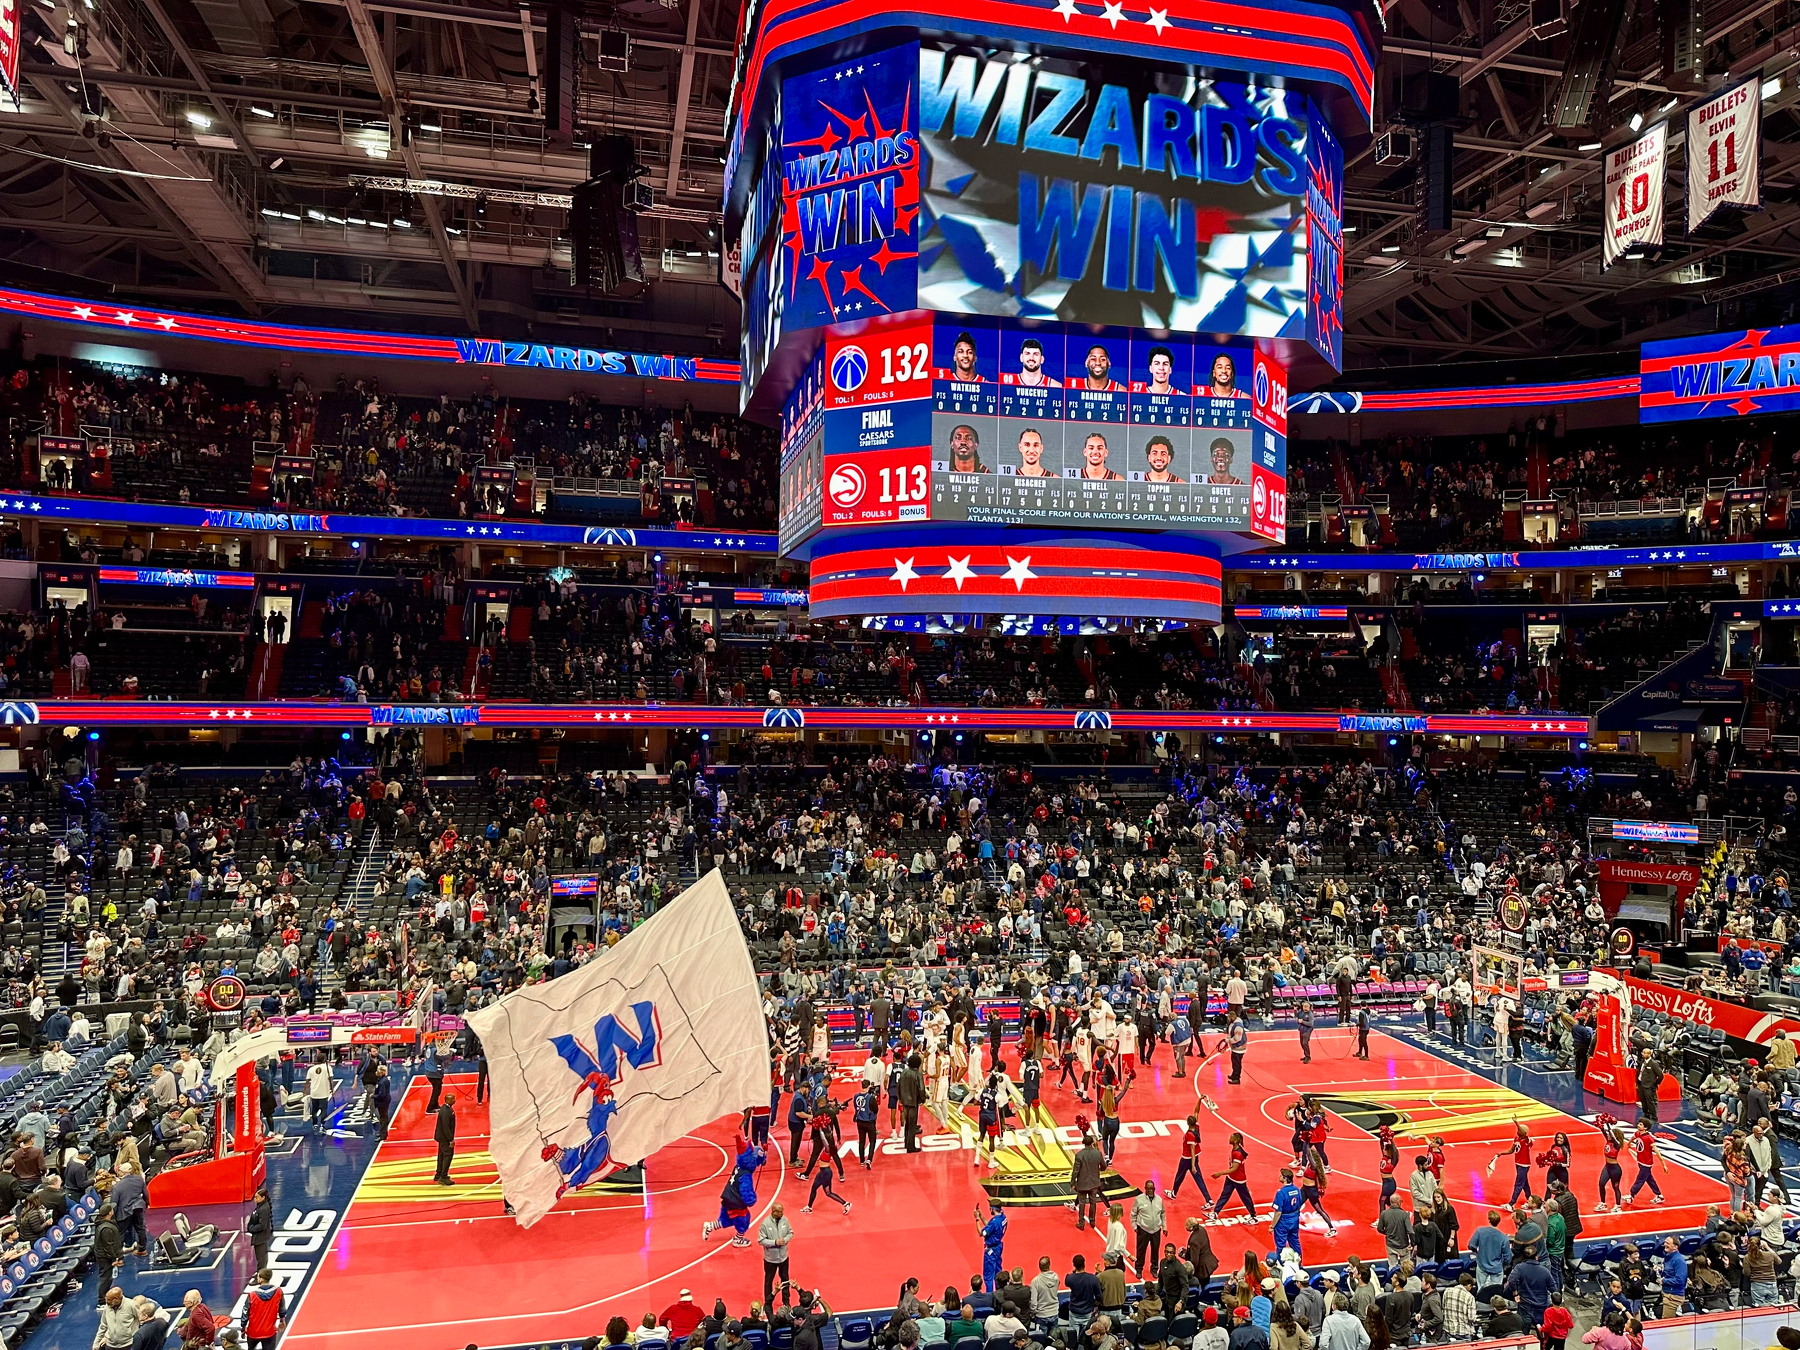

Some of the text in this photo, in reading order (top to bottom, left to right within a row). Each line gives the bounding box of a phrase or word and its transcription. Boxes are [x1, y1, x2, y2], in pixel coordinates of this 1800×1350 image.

[1700, 88, 1747, 124] BULLETS
[920, 47, 1306, 197] WIZARDS
[1709, 114, 1735, 137] ELVIN
[1614, 136, 1654, 167] BULLETS
[1708, 132, 1737, 183] 11
[784, 130, 915, 193] WIZARDS
[1607, 152, 1660, 184] EARL "THE PEARL"
[1617, 172, 1648, 222] 10
[1708, 179, 1737, 201] HAYES
[797, 176, 896, 256] WIN
[1614, 216, 1650, 239] MONROE
[1018, 173, 1199, 298] WIN
[454, 338, 696, 380] WIZARDS WIN
[881, 343, 928, 384] 132
[939, 369, 944, 378] 5
[1003, 374, 1013, 383] 00
[1670, 353, 1800, 398] WIZAR
[951, 383, 980, 393] WATKINS
[1133, 383, 1142, 392] 27
[1197, 387, 1205, 395] 13
[863, 392, 888, 400] FOULS:
[1272, 380, 1286, 420] 132
[1211, 399, 1235, 408] COOPER
[862, 409, 893, 430] FINAL
[859, 430, 894, 440] CAESARS
[859, 439, 888, 447] SPORTSBOOK
[949, 475, 980, 484] WALLACE
[1068, 470, 1076, 478] 14
[879, 465, 927, 503] 113
[1148, 485, 1170, 493] TOPPIN
[1212, 487, 1231, 496] GUEYE
[900, 508, 925, 516] BONUS
[1117, 502, 1122, 510] 0
[1149, 503, 1154, 511] 0
[1165, 504, 1169, 512] 0
[1180, 504, 1185, 512] 0
[1196, 505, 1247, 514] 7 5 0
[1270, 489, 1285, 525] 113
[207, 510, 288, 530] WIZARDS
[1133, 514, 1166, 522] CAPITAL,
[1418, 554, 1484, 568] WIZARDS
[138, 571, 194, 585] WIZARDS
[371, 707, 479, 723] WIZARDS WIN
[1340, 716, 1427, 730] WIZARDS WIN
[1622, 827, 1666, 837] WIZARDS
[1611, 866, 1694, 881] Hennessy Lofts
[1508, 901, 1518, 911] 0.0
[220, 985, 234, 994] 0.0
[1628, 985, 1715, 1024] nessy Lofts
[547, 1000, 662, 1086] W
[1030, 1071, 1035, 1080] 7
[983, 1099, 989, 1110] 5
